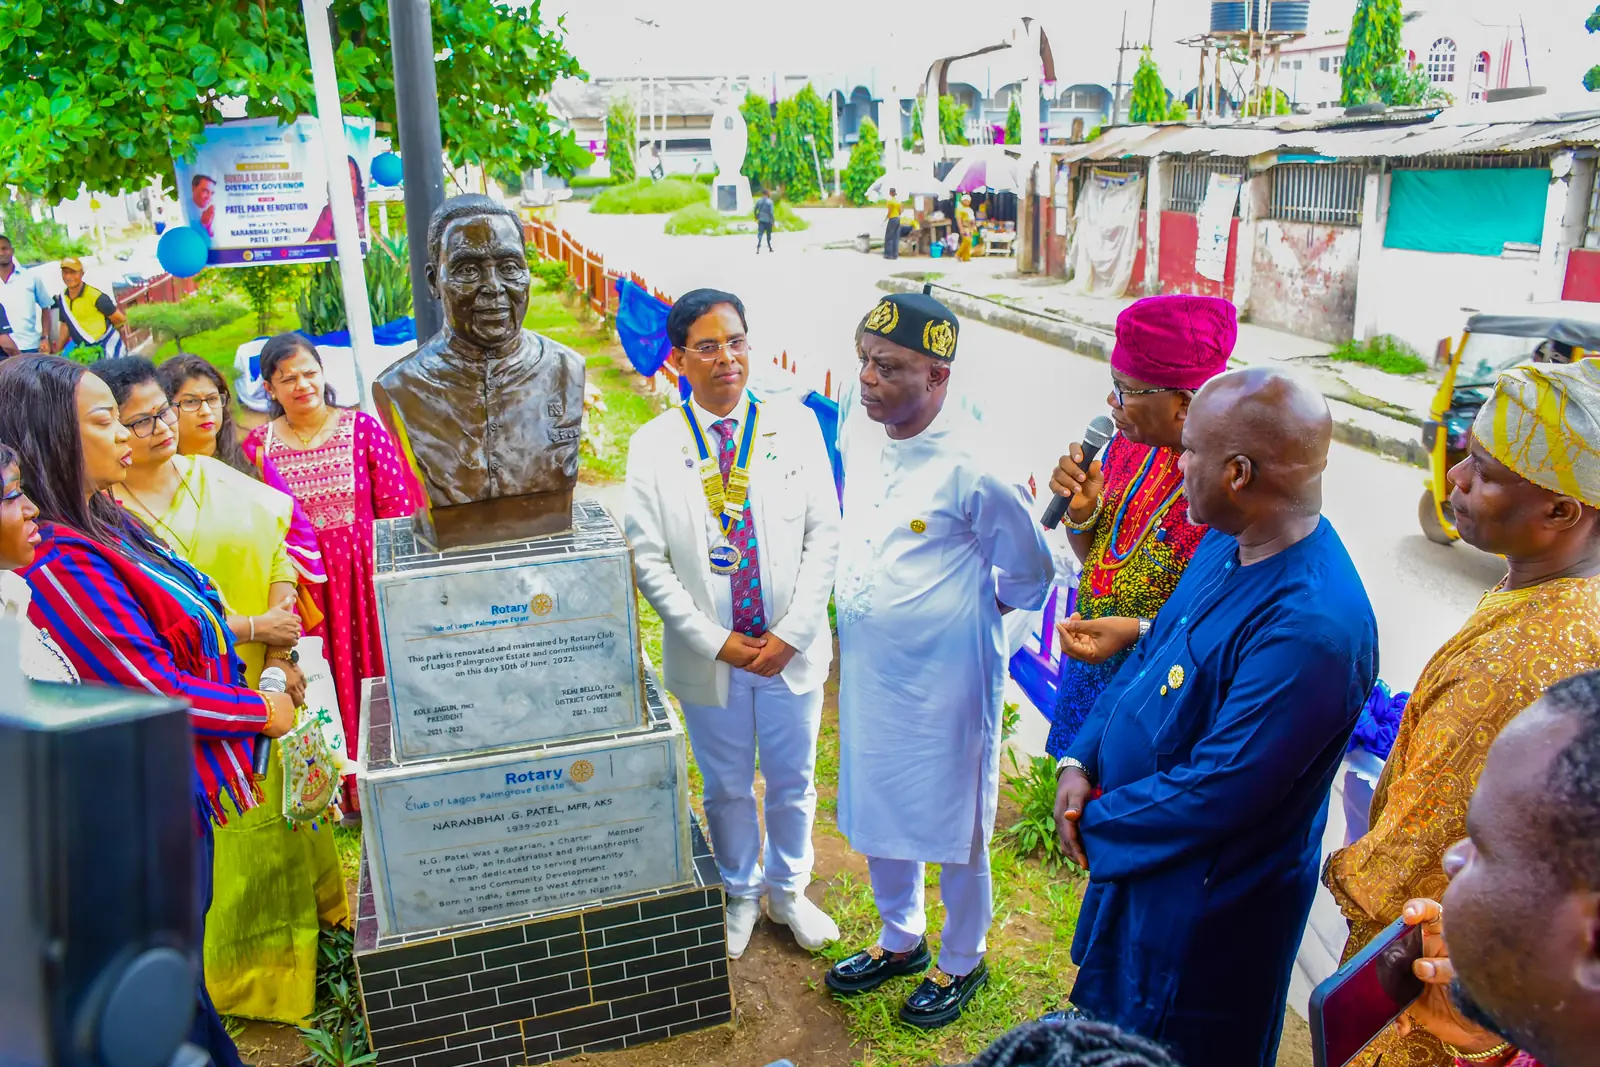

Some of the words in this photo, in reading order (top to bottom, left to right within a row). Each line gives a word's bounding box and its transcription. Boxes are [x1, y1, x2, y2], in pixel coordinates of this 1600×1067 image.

[225, 183, 259, 191] DISTRICT
[261, 181, 305, 190] GOVERNOR
[225, 204, 246, 214] PATEL
[247, 204, 265, 213] PARK
[266, 202, 309, 212] RENOVATION
[491, 603, 528, 615] Rotary
[455, 622, 474, 630] Lagos
[475, 617, 509, 626] Palmgrove
[426, 653, 444, 663] park
[454, 646, 495, 657] renovated
[496, 644, 512, 652] and
[513, 638, 557, 650] maintained
[558, 637, 568, 645] by
[570, 633, 596, 644] Rotary
[597, 631, 615, 640] Club
[430, 662, 455, 670] Lagos
[456, 656, 504, 667] Palmgroove
[505, 652, 531, 661] Estate
[532, 649, 548, 657] and
[548, 642, 604, 655] commissioned
[483, 666, 498, 675] day
[500, 662, 518, 671] 30th
[520, 661, 528, 669] of
[552, 656, 576, 665] 2022.
[562, 688, 578, 696] REMI
[579, 684, 603, 693] BELLO,
[555, 696, 584, 706] DISTRICT
[586, 691, 622, 702] GOVERNOR
[413, 708, 432, 716] KOLE
[433, 704, 459, 713] JAGUN,
[427, 712, 463, 723] PRESIDENT
[572, 709, 587, 717] 2021
[427, 728, 443, 737] 2021
[448, 725, 464, 734] 2022
[505, 768, 563, 784] Rotary
[405, 802, 430, 811] Club
[433, 798, 444, 807] of
[447, 796, 477, 805] Lagos
[480, 787, 532, 799] Palmgrove
[535, 782, 565, 792] Estate
[432, 813, 505, 831] NARANBHAI
[526, 805, 565, 817] PATEL,
[567, 802, 591, 812] MFR,
[593, 798, 613, 807] AKS
[506, 819, 560, 833] 1939-2021
[419, 857, 441, 866] N.G.
[444, 853, 470, 862] Patel
[503, 843, 546, 853] Rotarian,
[557, 834, 593, 845] Charter
[607, 826, 645, 837] Member
[422, 869, 433, 877] of
[435, 867, 452, 875] the
[455, 863, 480, 872] club,
[496, 851, 553, 864] Industrialist
[555, 848, 573, 857] and
[458, 874, 479, 883] man
[481, 865, 529, 879] dedicated
[543, 858, 577, 870] serving
[580, 851, 624, 863] Humanity
[469, 884, 487, 892] and
[489, 874, 543, 889] Community
[545, 864, 609, 880] Development.
[438, 899, 461, 908] Born
[475, 893, 502, 901] India,
[505, 889, 531, 897] came
[546, 881, 569, 890] West
[571, 876, 598, 887] Africa
[613, 869, 637, 878] 1957,
[457, 907, 475, 916] and
[477, 903, 503, 913] spent
[505, 899, 529, 908] most
[544, 893, 557, 902] his
[559, 891, 576, 899] life
